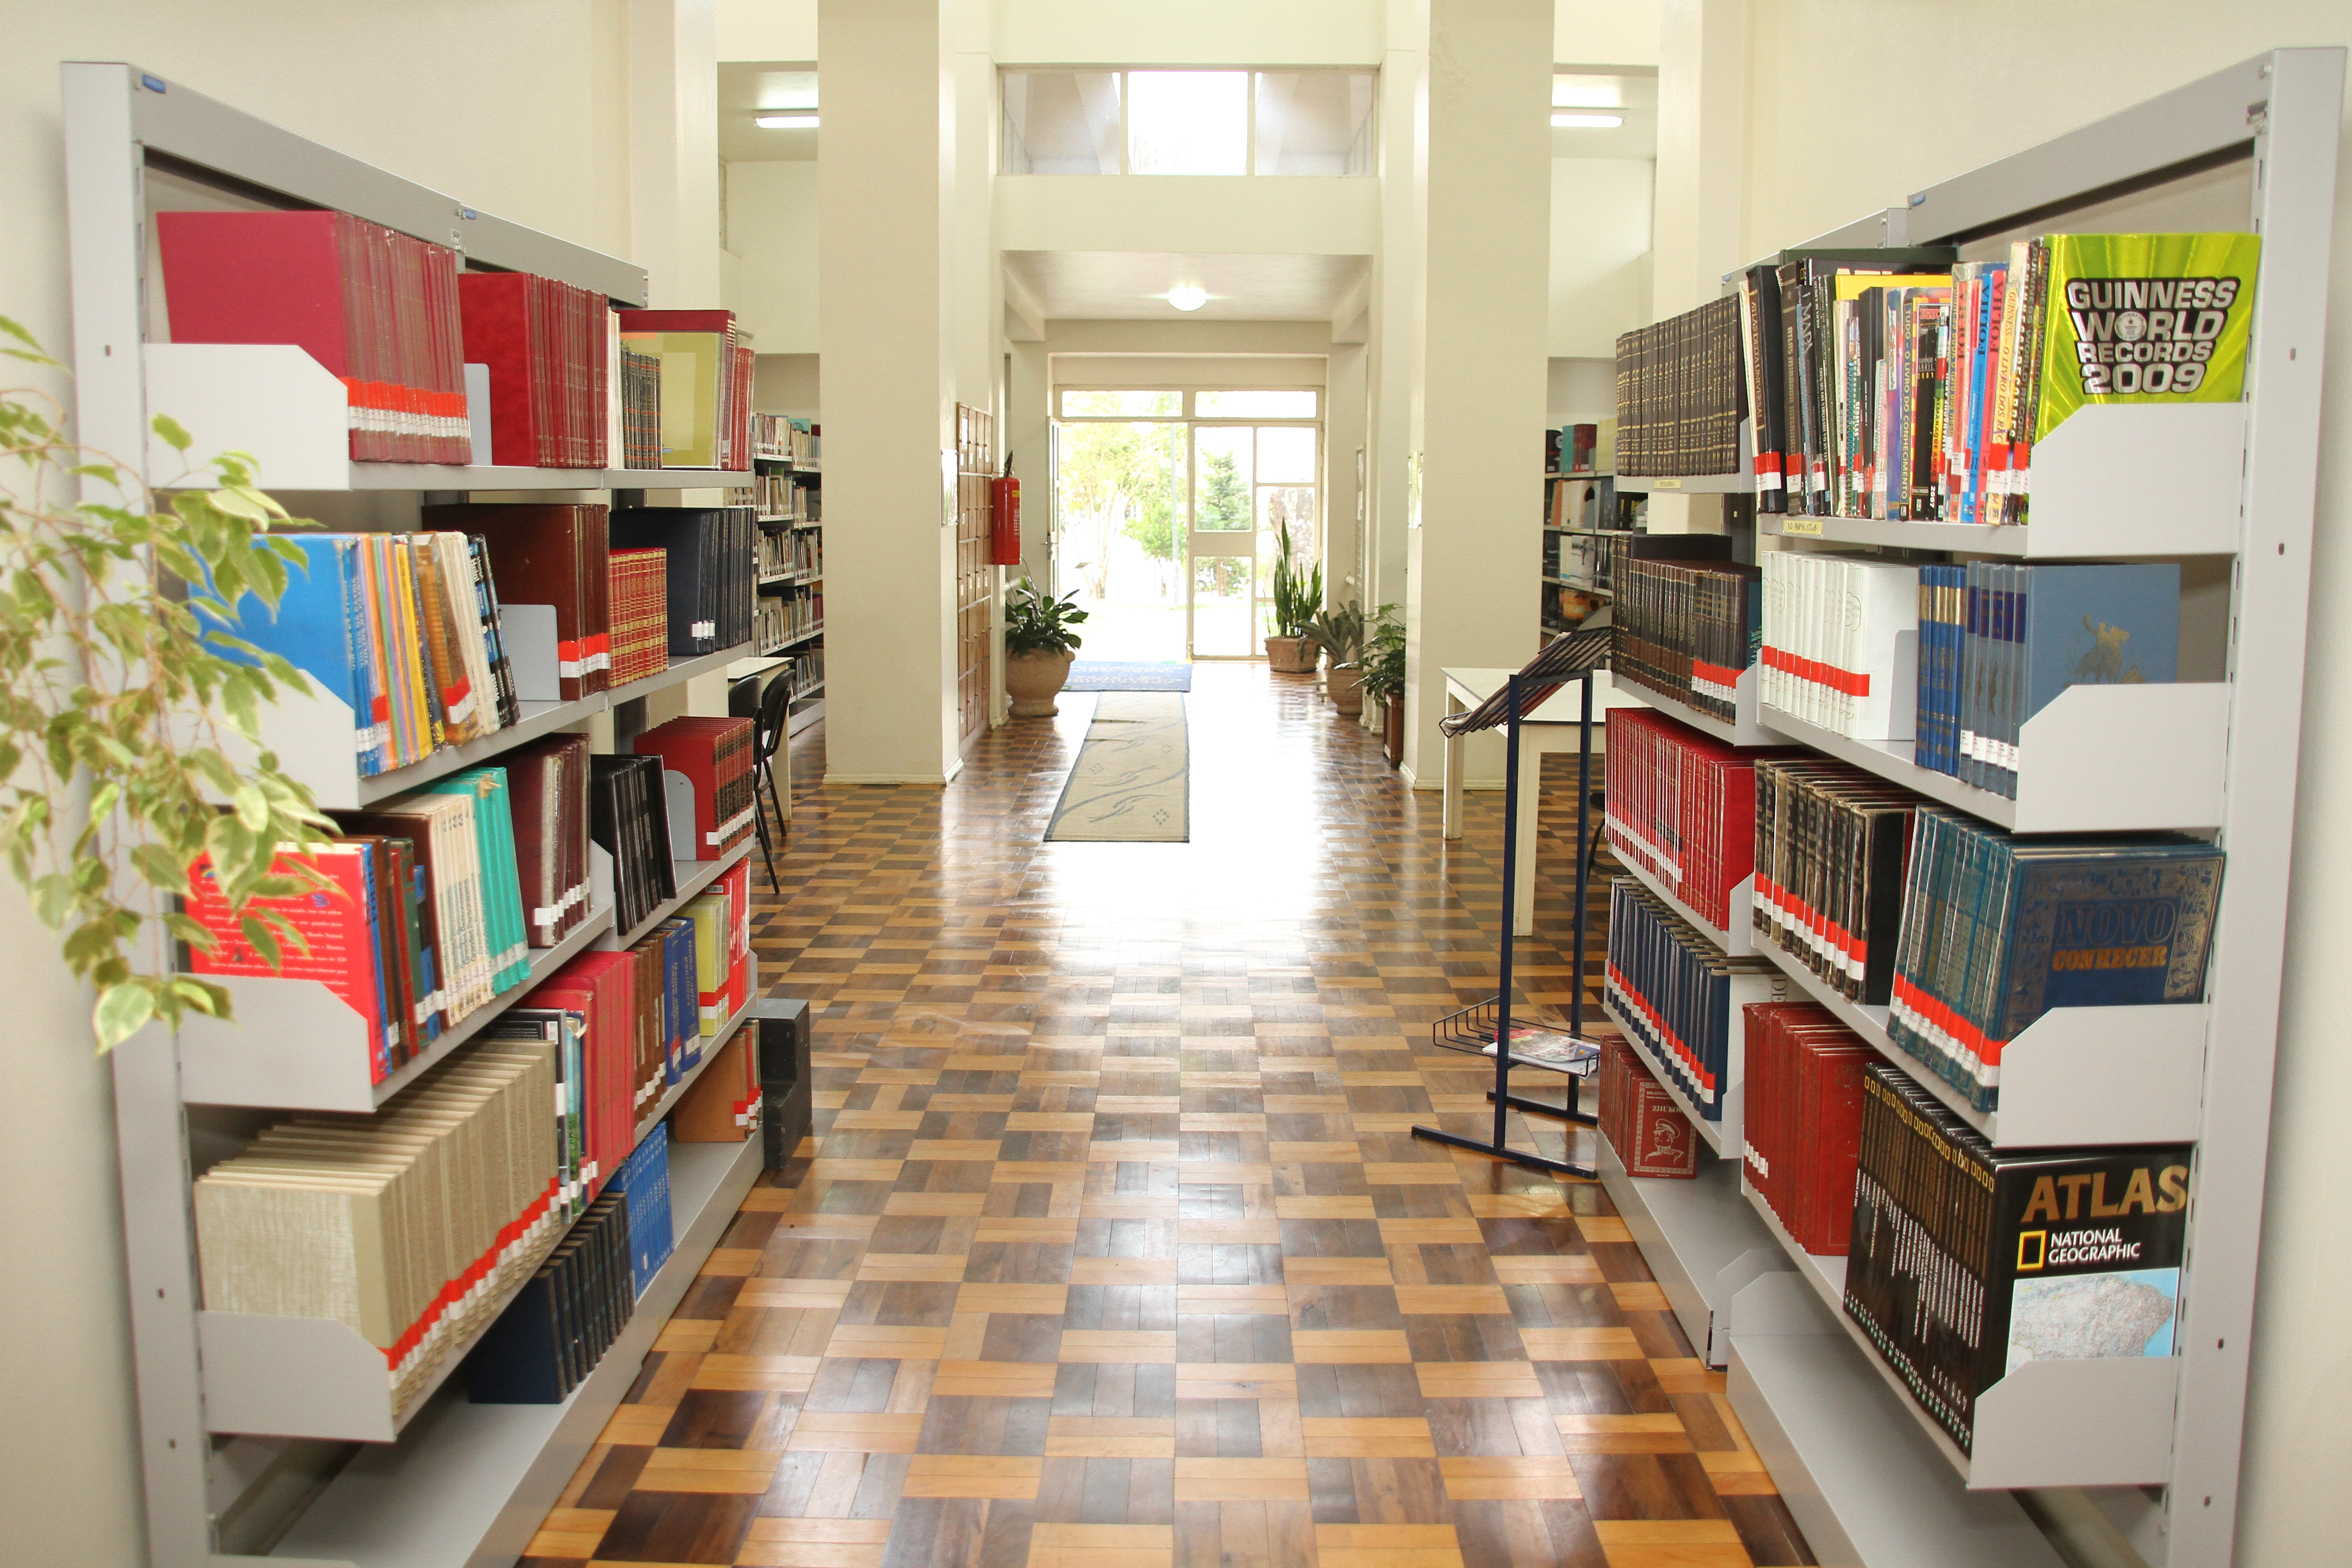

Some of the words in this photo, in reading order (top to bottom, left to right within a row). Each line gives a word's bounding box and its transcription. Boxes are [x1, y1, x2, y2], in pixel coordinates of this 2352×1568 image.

[2068, 280, 2238, 309] GUINNESS
[1802, 302, 1813, 354] MAPA
[1958, 291, 1966, 359] FOLHA
[1978, 284, 1989, 356] FOLHA
[1990, 282, 2003, 353] FOLHA
[2005, 291, 2016, 336] GUINNESS
[2071, 310, 2226, 341] WORLD
[1905, 351, 1911, 359] O
[2003, 346, 2009, 354] O
[2077, 341, 2214, 363] RECORDS
[1999, 358, 2009, 393] LIVRO
[2081, 363, 2205, 394] 2009
[1754, 364, 1763, 421] UNIVERSAL
[1904, 397, 1910, 412] DO
[1998, 395, 2006, 417] DOS
[470, 558, 480, 582] Help!
[2056, 901, 2176, 946] NOVO
[2053, 945, 2168, 971] CONHECER
[2020, 1165, 2189, 1224] ATLAS
[2048, 1242, 2142, 1264] GEOGRAPHIC
[2051, 1227, 2123, 1248] NATIONAL
